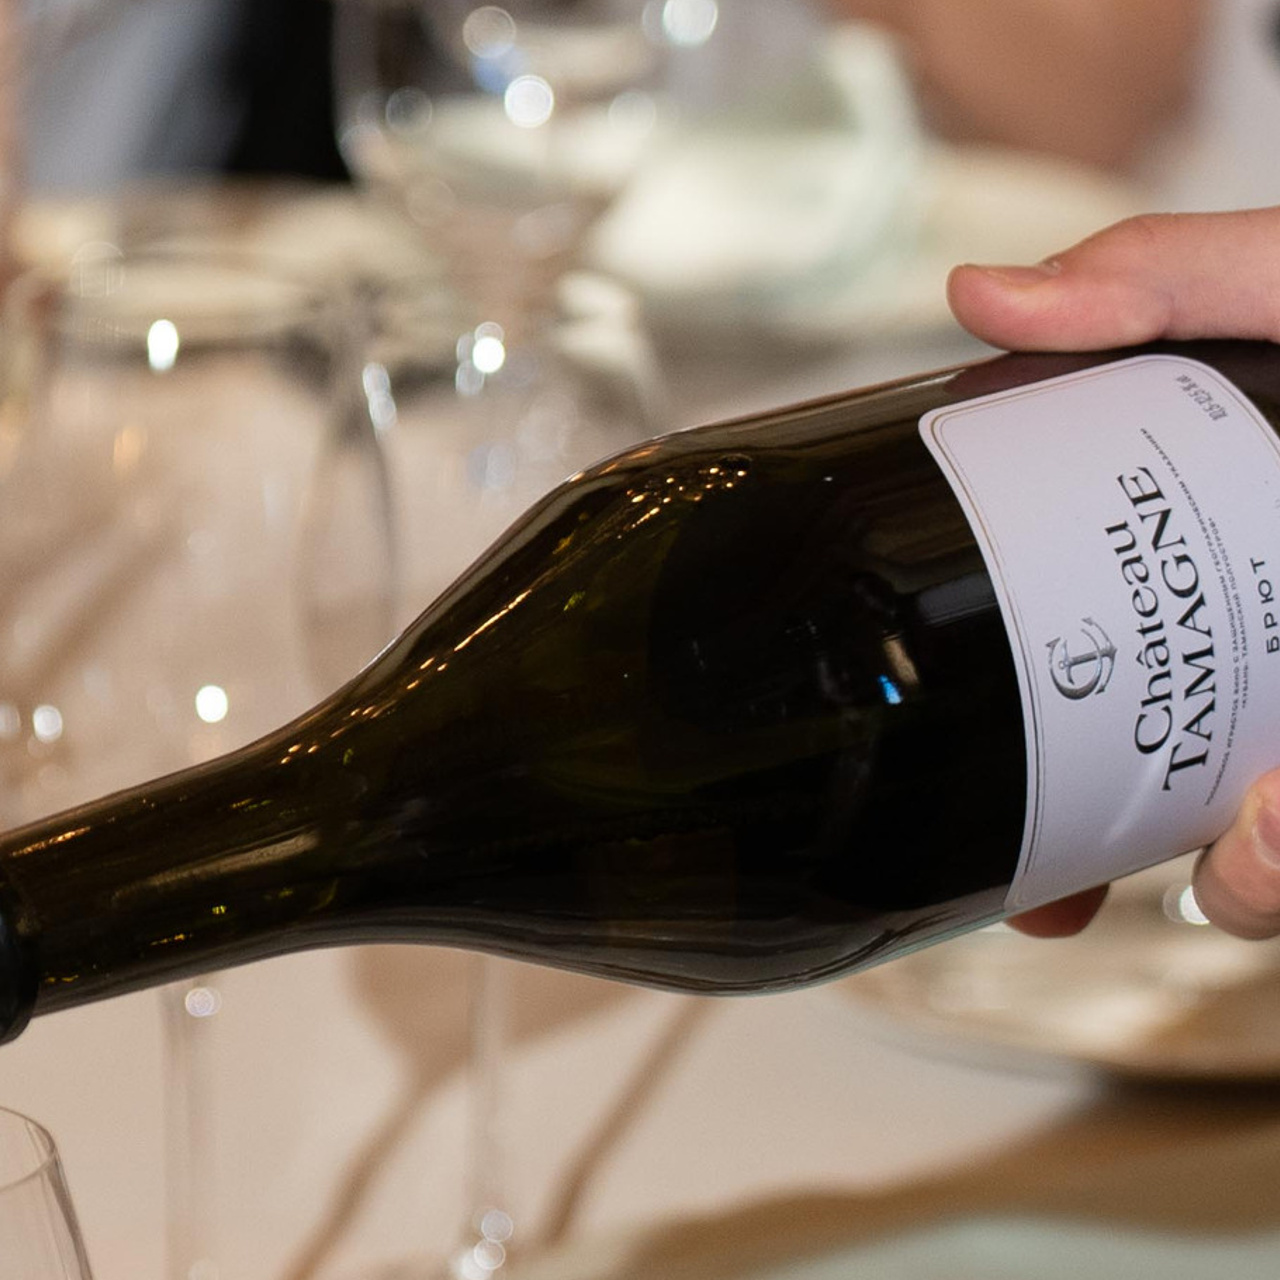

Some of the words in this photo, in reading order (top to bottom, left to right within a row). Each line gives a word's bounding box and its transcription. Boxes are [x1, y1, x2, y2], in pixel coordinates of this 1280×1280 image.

[1105, 522, 1172, 755] Château
[1118, 466, 1216, 790] TAMAGNE
[1250, 557, 1280, 654] БРЮТ
